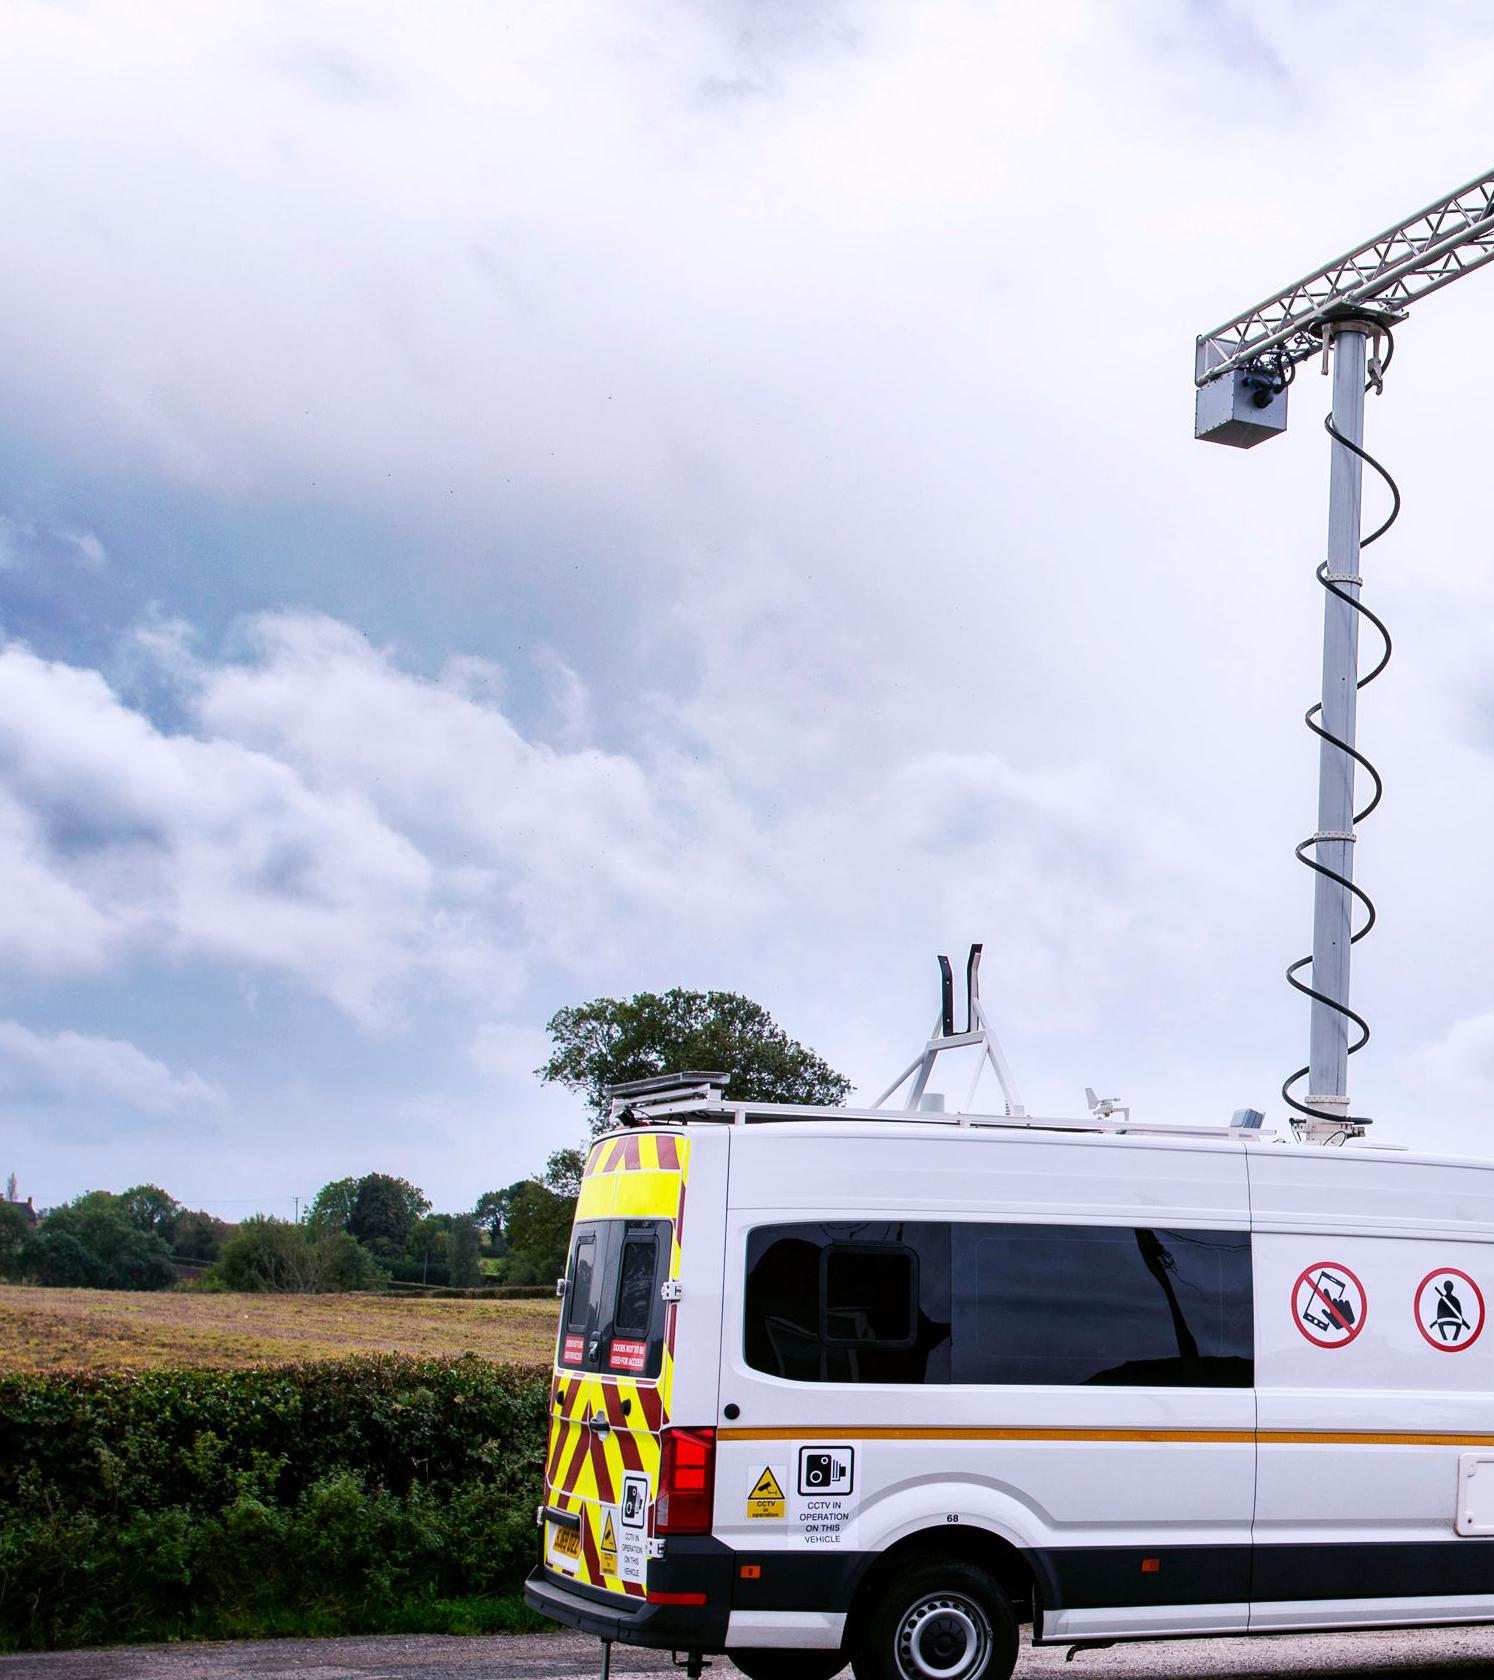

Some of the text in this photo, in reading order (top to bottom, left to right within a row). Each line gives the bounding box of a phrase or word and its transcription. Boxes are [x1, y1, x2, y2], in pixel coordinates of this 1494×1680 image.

[947, 1514, 959, 1522] 68
[622, 1544, 642, 1554] OPERATION
[624, 1555, 631, 1563] ON
[624, 1568, 640, 1577] VEHICLE
